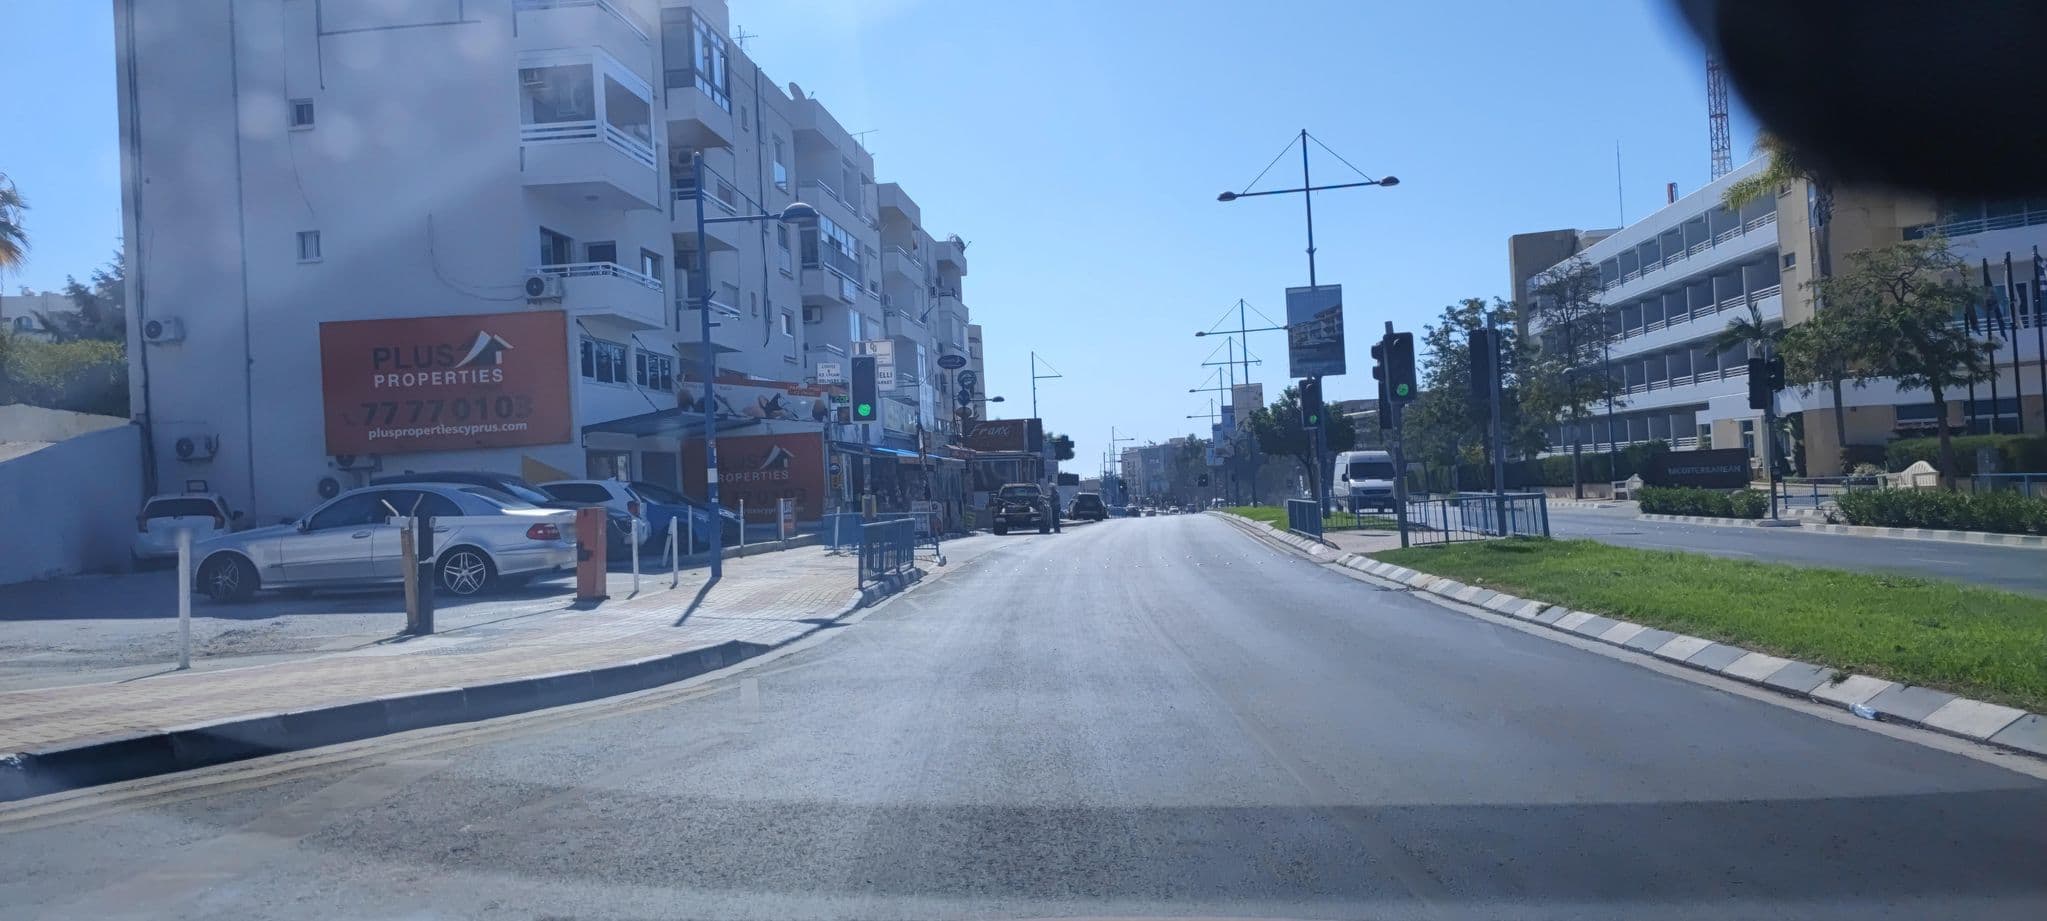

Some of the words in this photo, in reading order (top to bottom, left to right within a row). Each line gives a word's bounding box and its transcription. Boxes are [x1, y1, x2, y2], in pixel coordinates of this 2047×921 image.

[372, 344, 455, 370] PLUS
[374, 368, 504, 388] PROPERTIES
[368, 420, 528, 440] pluspropertiescyprus.com
[719, 470, 790, 483] ROPERTIES
